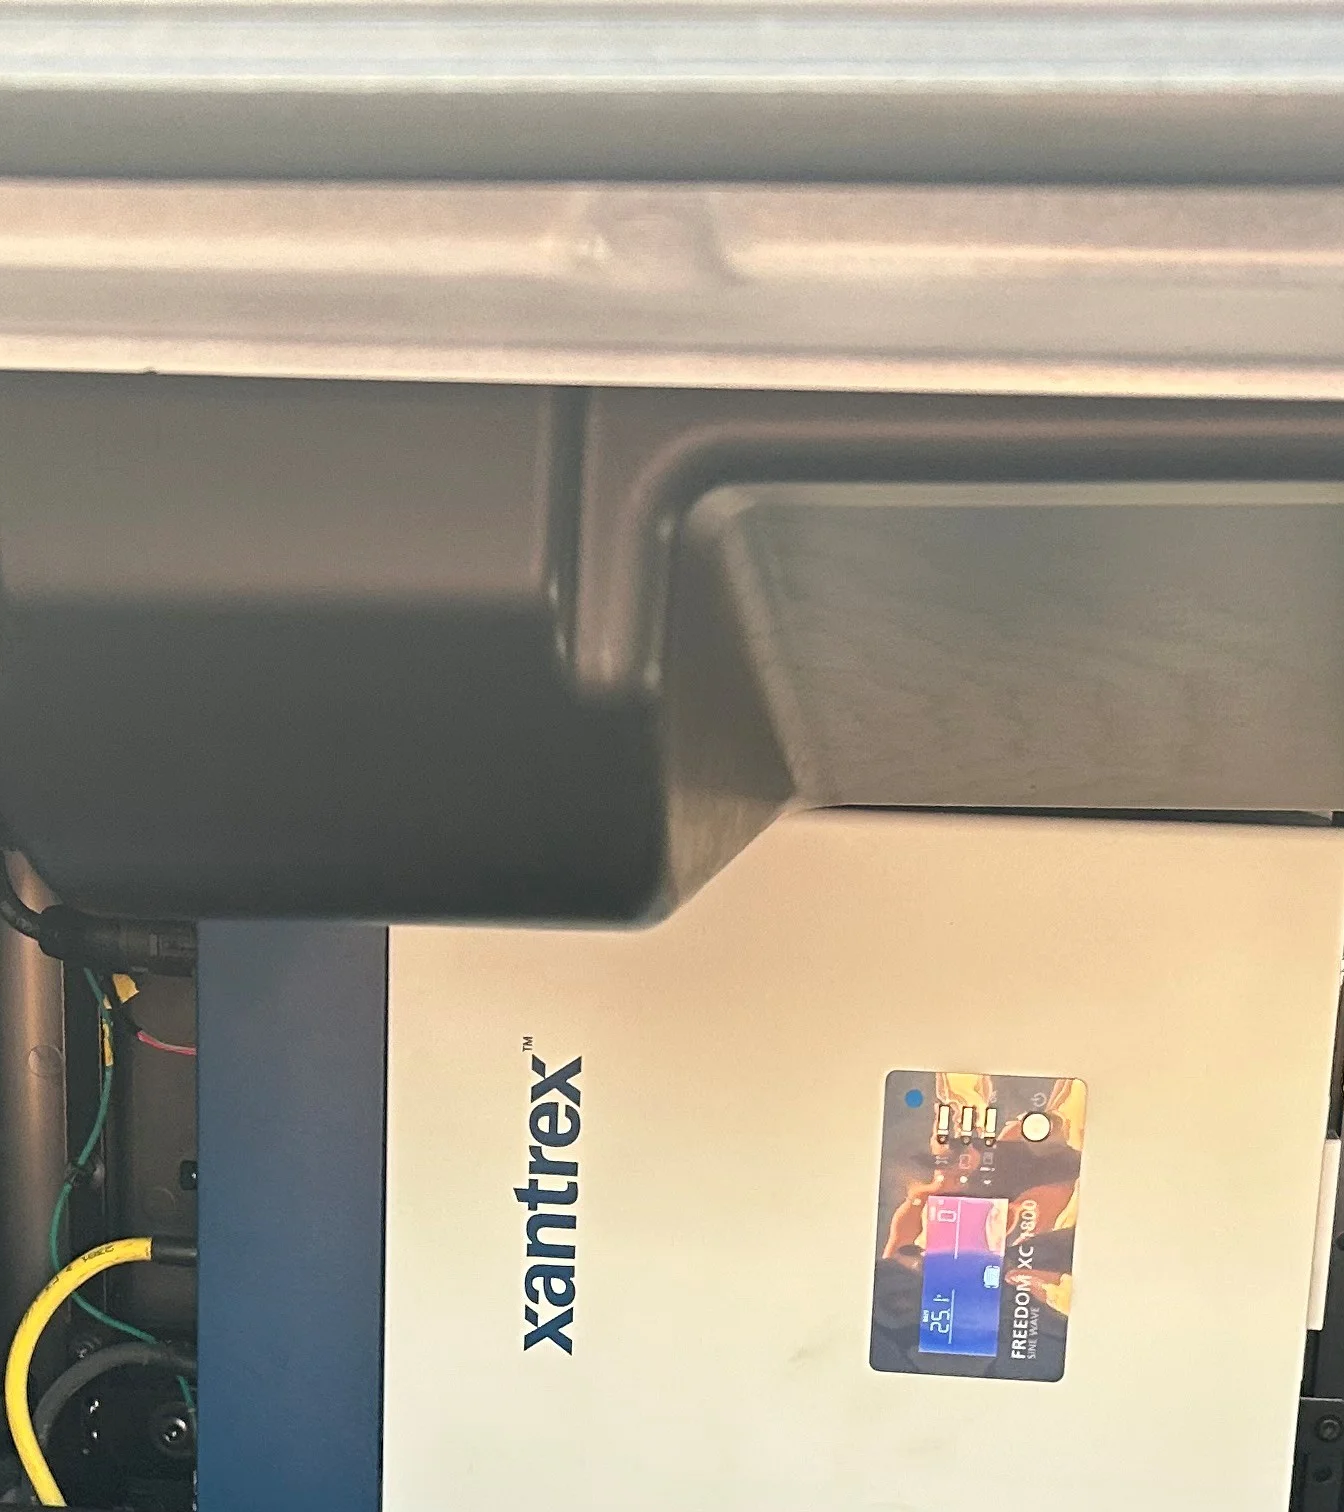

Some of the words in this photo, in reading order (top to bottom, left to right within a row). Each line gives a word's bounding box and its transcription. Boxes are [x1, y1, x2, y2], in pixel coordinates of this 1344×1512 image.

[513, 1054, 582, 1356] xantrex
[1020, 1200, 1038, 1240] 1800
[1018, 1245, 1034, 1270] XC
[1011, 1274, 1032, 1360] FREEDOM
[1029, 1306, 1040, 1335] WAVE
[1027, 1336, 1037, 1360] SINE
